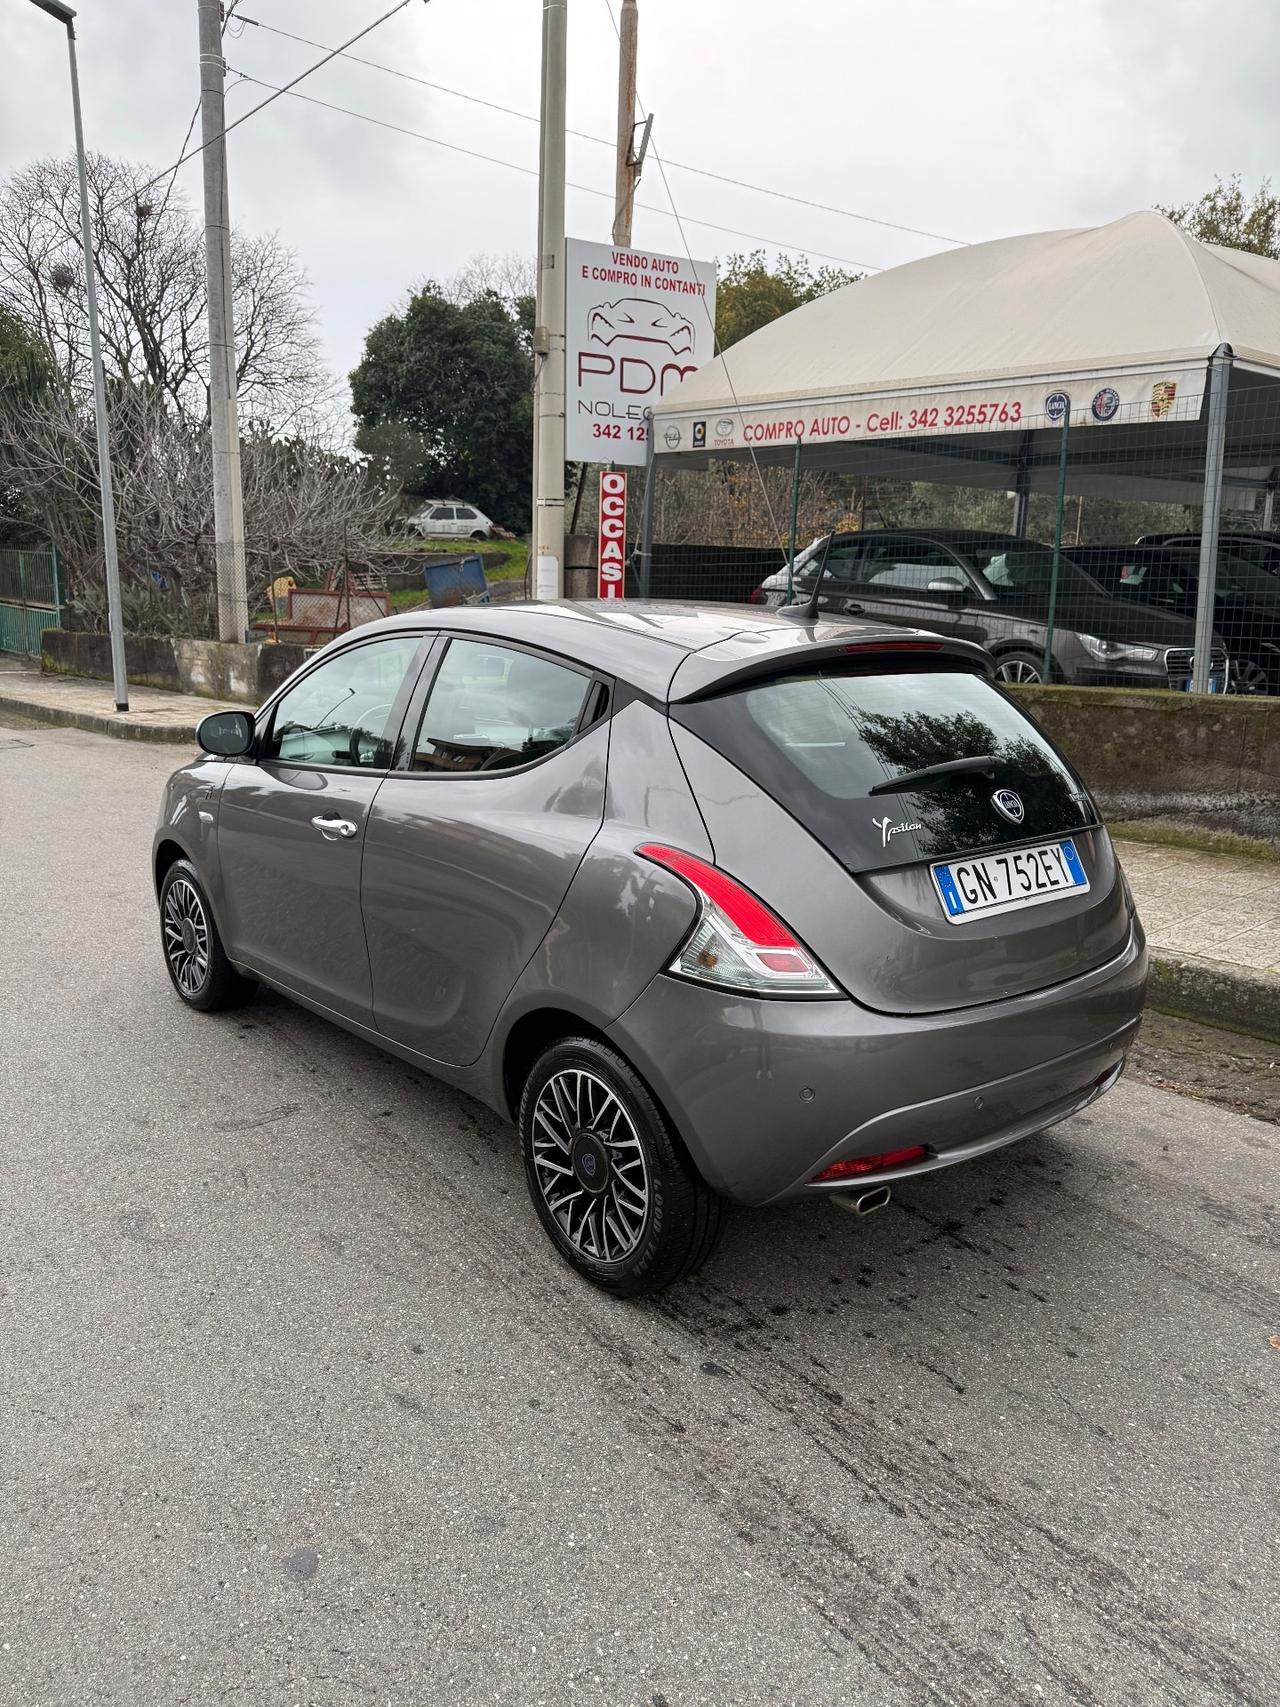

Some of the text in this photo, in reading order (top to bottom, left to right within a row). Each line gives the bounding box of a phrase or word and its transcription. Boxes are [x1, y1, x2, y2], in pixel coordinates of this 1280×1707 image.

[612, 251, 679, 274] VENDO AUTO
[582, 265, 706, 297] E COMPRO IN CONTANTI
[592, 423, 649, 441] 342 12
[743, 419, 805, 443] COMPRO
[809, 415, 850, 437] AUTO
[867, 410, 902, 433] Cell:
[907, 407, 938, 430] 342
[943, 401, 1022, 427] 3255763
[872, 816, 922, 847] Ypsilon
[956, 862, 997, 904] GN
